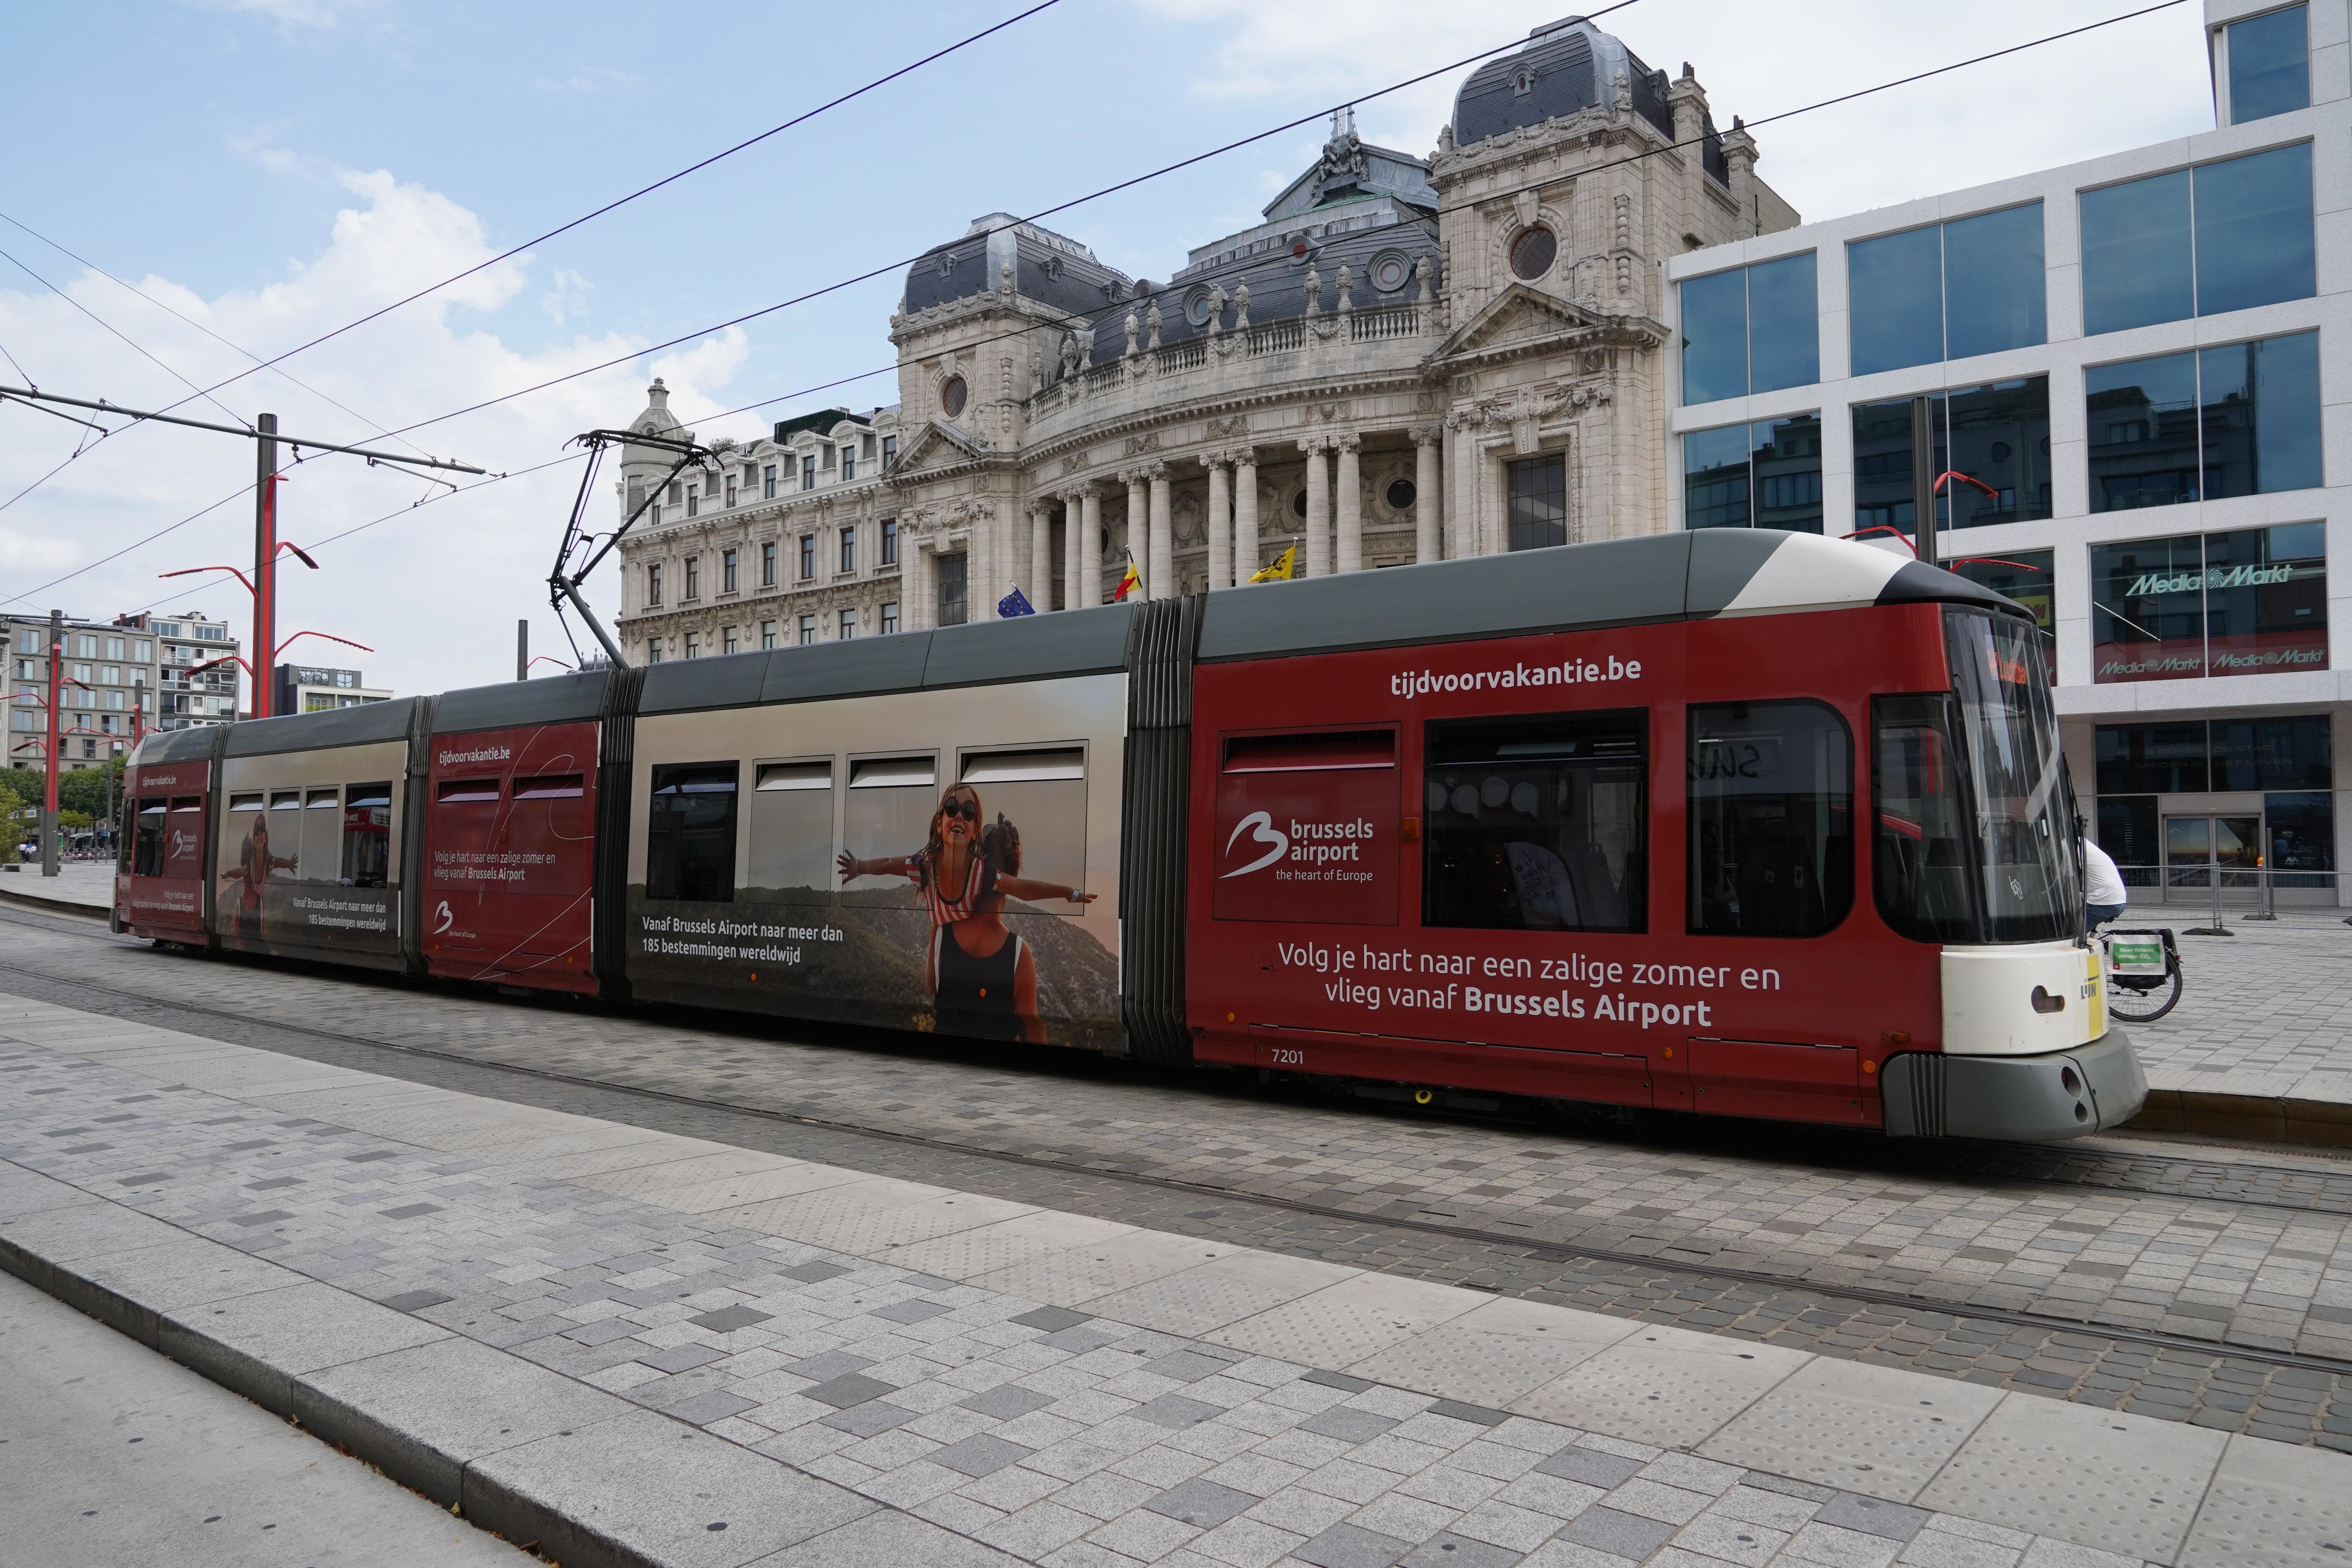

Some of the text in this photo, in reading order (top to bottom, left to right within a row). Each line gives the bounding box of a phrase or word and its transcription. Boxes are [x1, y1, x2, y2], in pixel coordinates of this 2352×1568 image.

[2125, 564, 2293, 596] Media Markt
[2098, 658, 2201, 675] Media Markt
[2213, 649, 2324, 668] Media Markt
[1392, 655, 1641, 699] tijdvoorvakantie.be
[440, 746, 510, 766] tijdvoorvakantie.be
[1291, 818, 1373, 839] brussels
[435, 850, 555, 866] Volg je hart naar een zalige zomer en
[1291, 840, 1359, 865] airport
[434, 866, 525, 882] vlieg vanaf Brussels Airport
[1276, 869, 1372, 883] the heart of Europe
[293, 897, 307, 907] Vanaf
[308, 898, 328, 909] Brussels
[329, 899, 347, 912] Airport
[361, 904, 375, 912] meer
[376, 902, 386, 913] dan
[309, 914, 386, 932] 185 bestemmingen wereldwijd
[643, 917, 843, 941] Vanaf Brussels Airport naar meer dan
[643, 938, 800, 965] 185 bestemmingen wereldwijd
[1279, 942, 1779, 989] Volg je hart naar een zalige zomer en
[1325, 977, 1711, 1028] vlieg vanaf Brussels Airport
[1272, 1049, 1303, 1064] 7201
